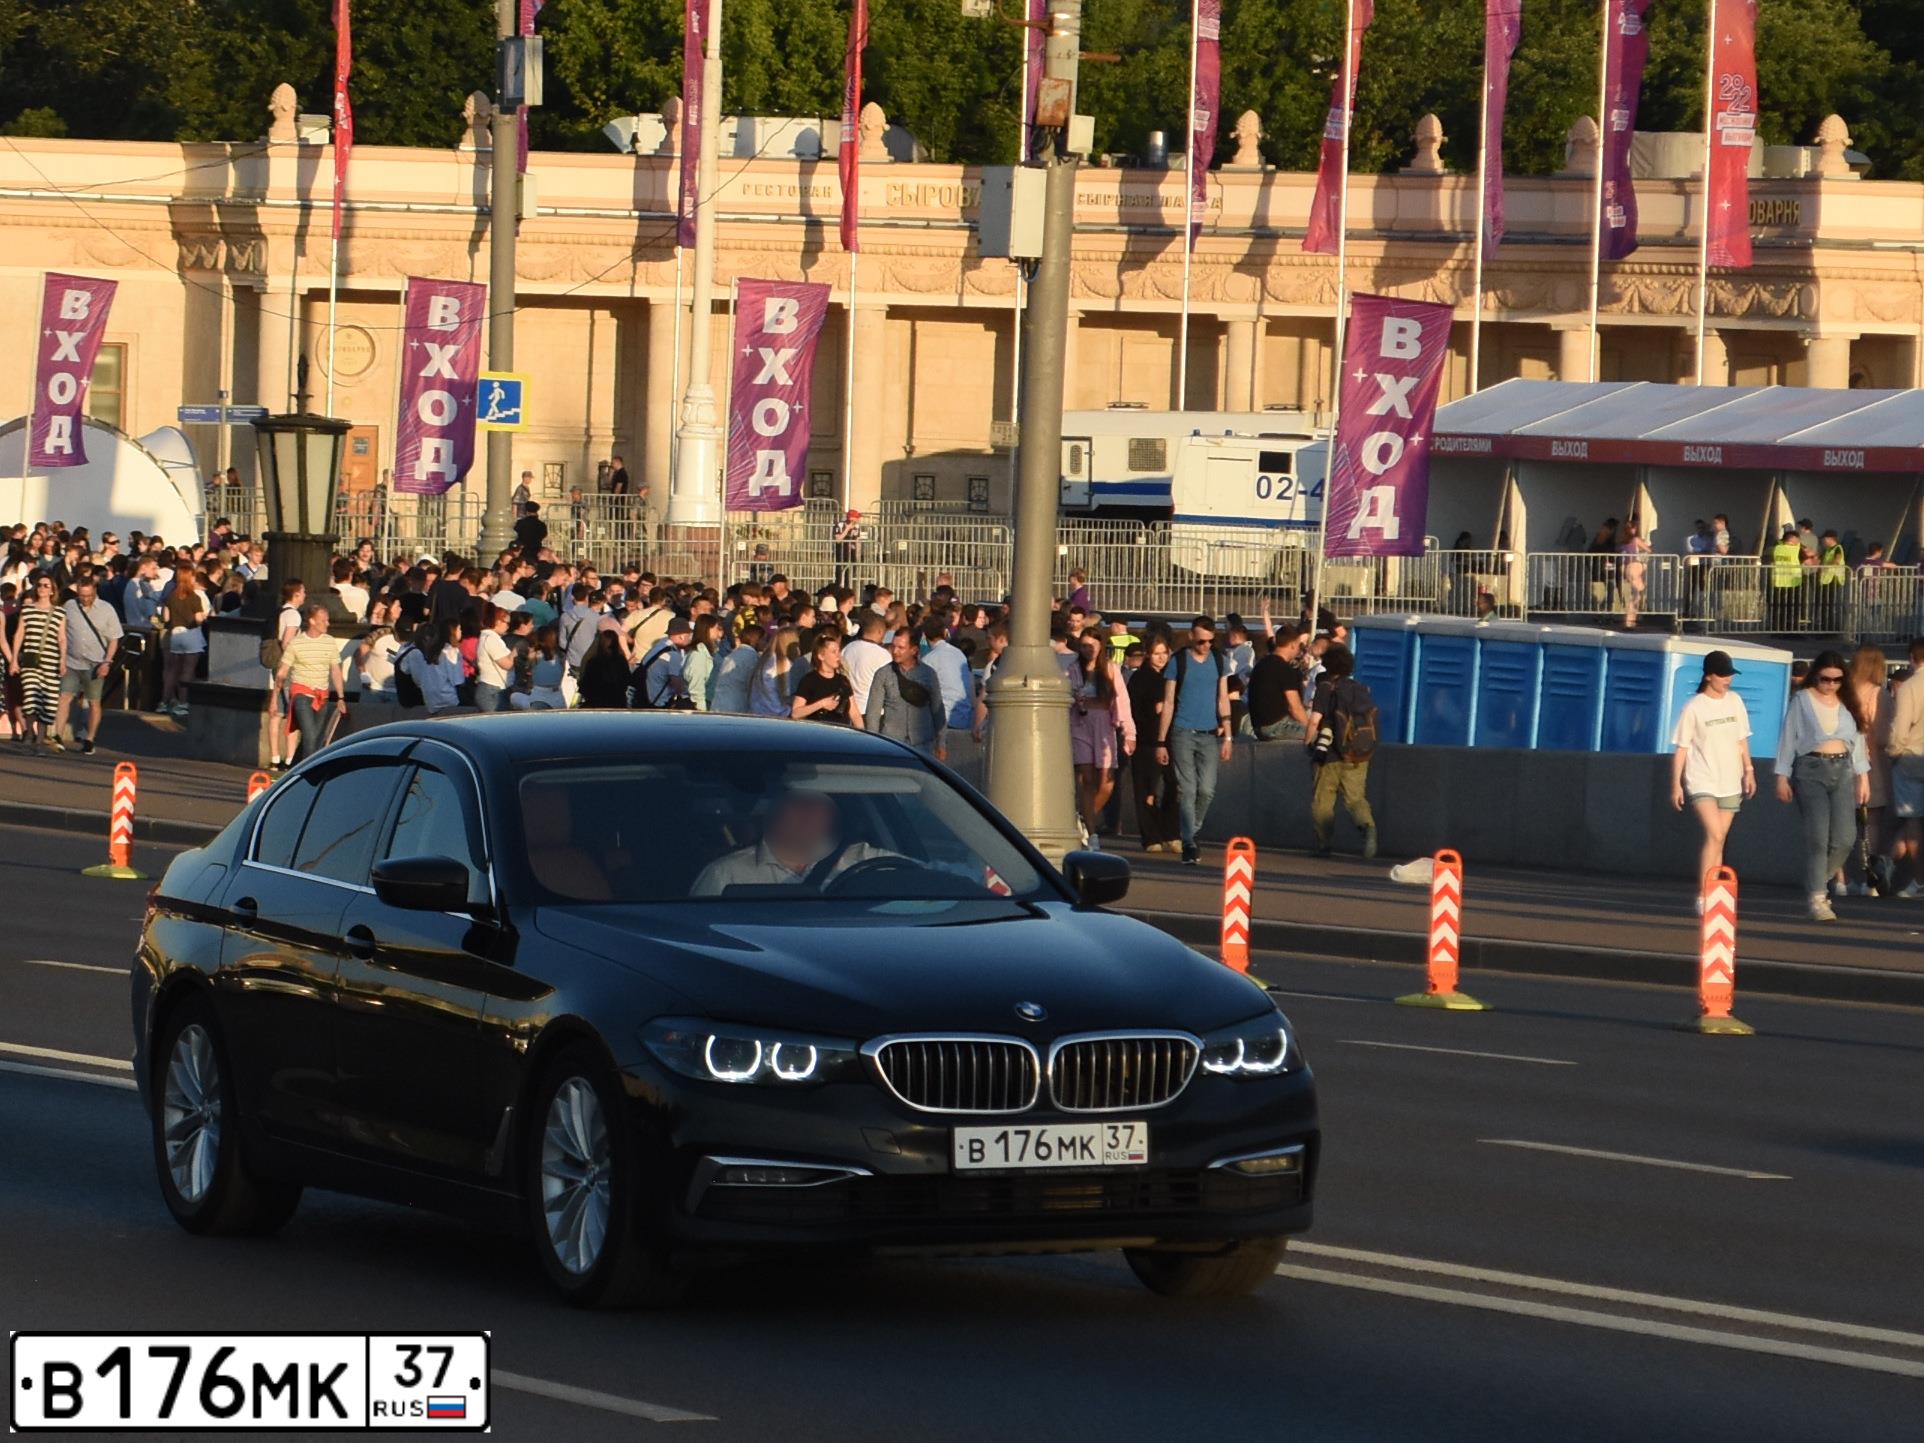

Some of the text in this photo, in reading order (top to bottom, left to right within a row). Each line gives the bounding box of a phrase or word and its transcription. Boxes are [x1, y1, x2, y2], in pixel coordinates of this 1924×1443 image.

[45, 289, 91, 454] ВХОД
[414, 295, 461, 482] ВХОД
[749, 297, 800, 496] ВХОД
[1347, 316, 1422, 539] ВХОД
[1435, 436, 1492, 452] РОДИТЕЛЯМИ
[1552, 440, 1588, 459] ВЫХОД
[1683, 445, 1722, 464] ВЫХОД
[1824, 450, 1865, 469] ВЫХОД
[1107, 1125, 1135, 1149] 37
[1105, 1151, 1128, 1160] RUS
